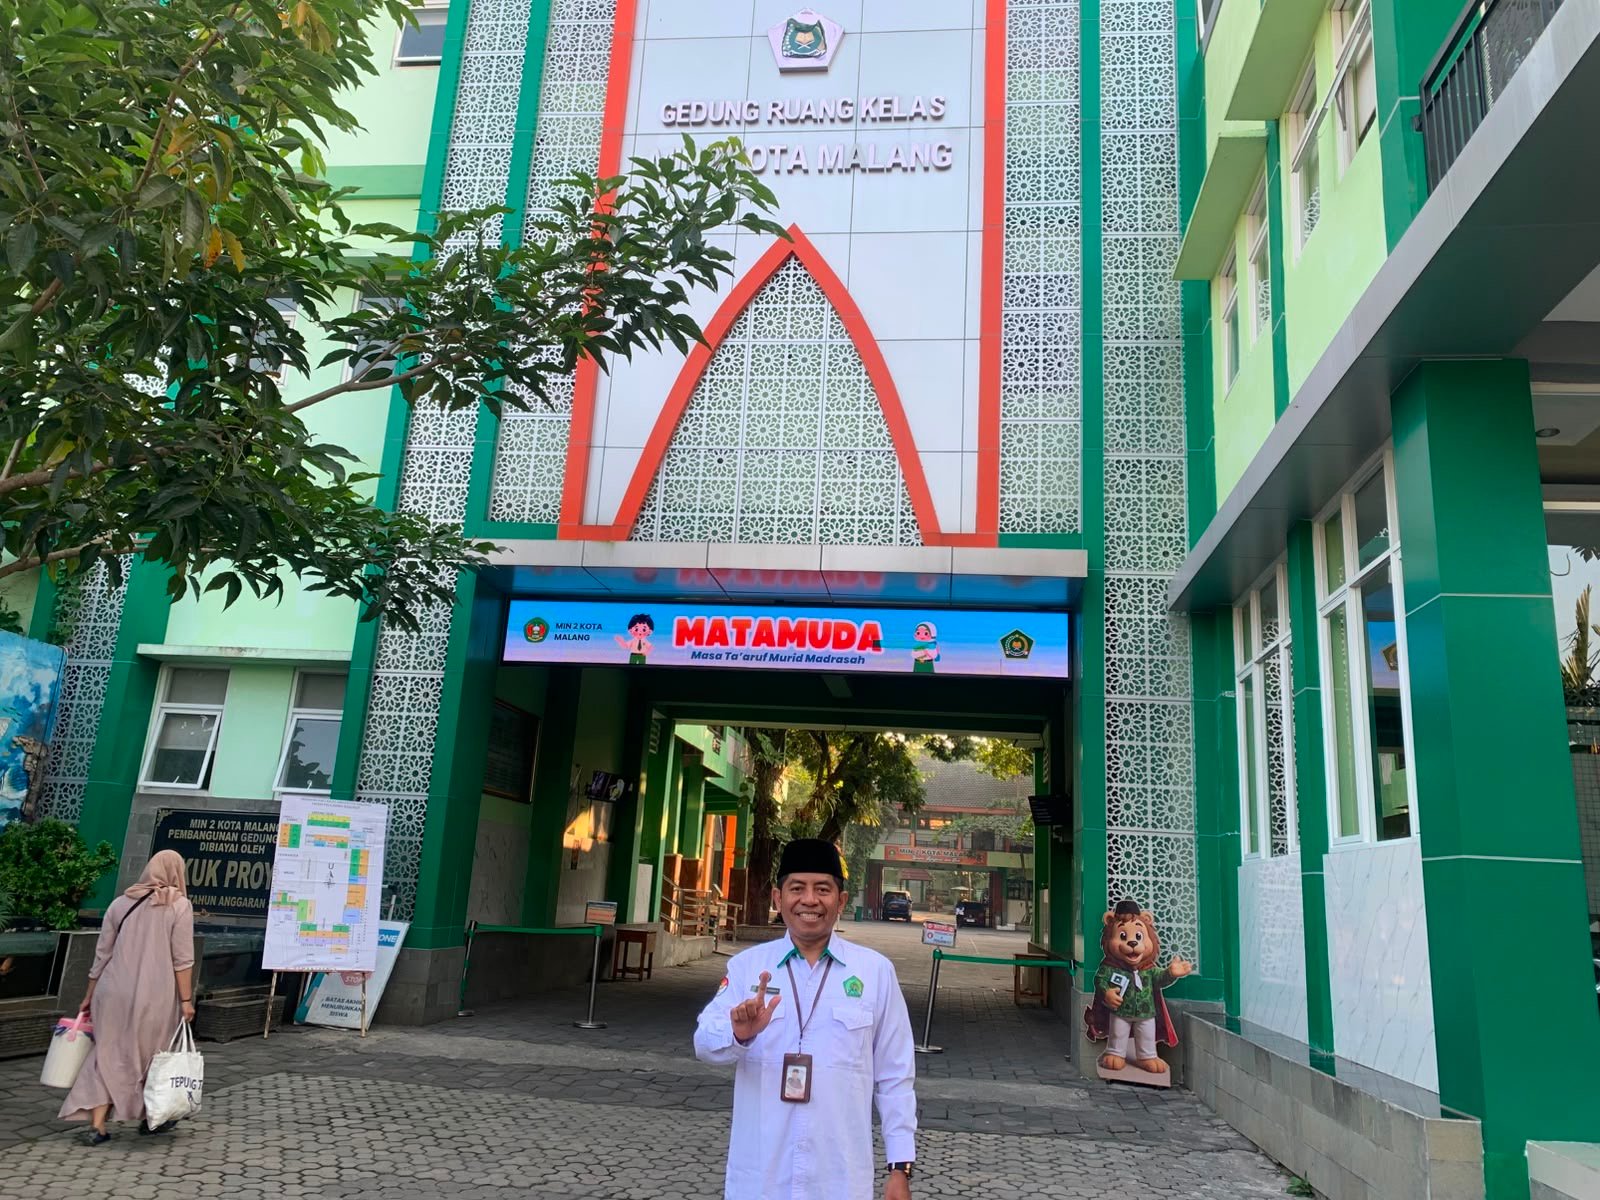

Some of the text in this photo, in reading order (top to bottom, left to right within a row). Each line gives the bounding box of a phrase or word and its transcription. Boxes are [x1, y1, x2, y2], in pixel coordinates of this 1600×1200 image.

[660, 95, 946, 127] GEDUNG RUANG KELAS
[733, 143, 809, 174] OTA
[817, 142, 953, 173] MALANG
[555, 622, 603, 632] MIN 2 KOTA
[673, 616, 883, 651] MATAMUDA
[554, 632, 591, 642] MALANG
[691, 650, 722, 661] Masa
[768, 652, 803, 664] Murid
[804, 653, 866, 666] Madrasah
[190, 818, 208, 829] MIN
[209, 820, 215, 830] 2
[217, 820, 241, 832] KOTA
[168, 829, 238, 842] PEMBANGUNAN
[199, 841, 266, 855] DIBIAYAI OLEH
[218, 895, 266, 909] ANGGARAN
